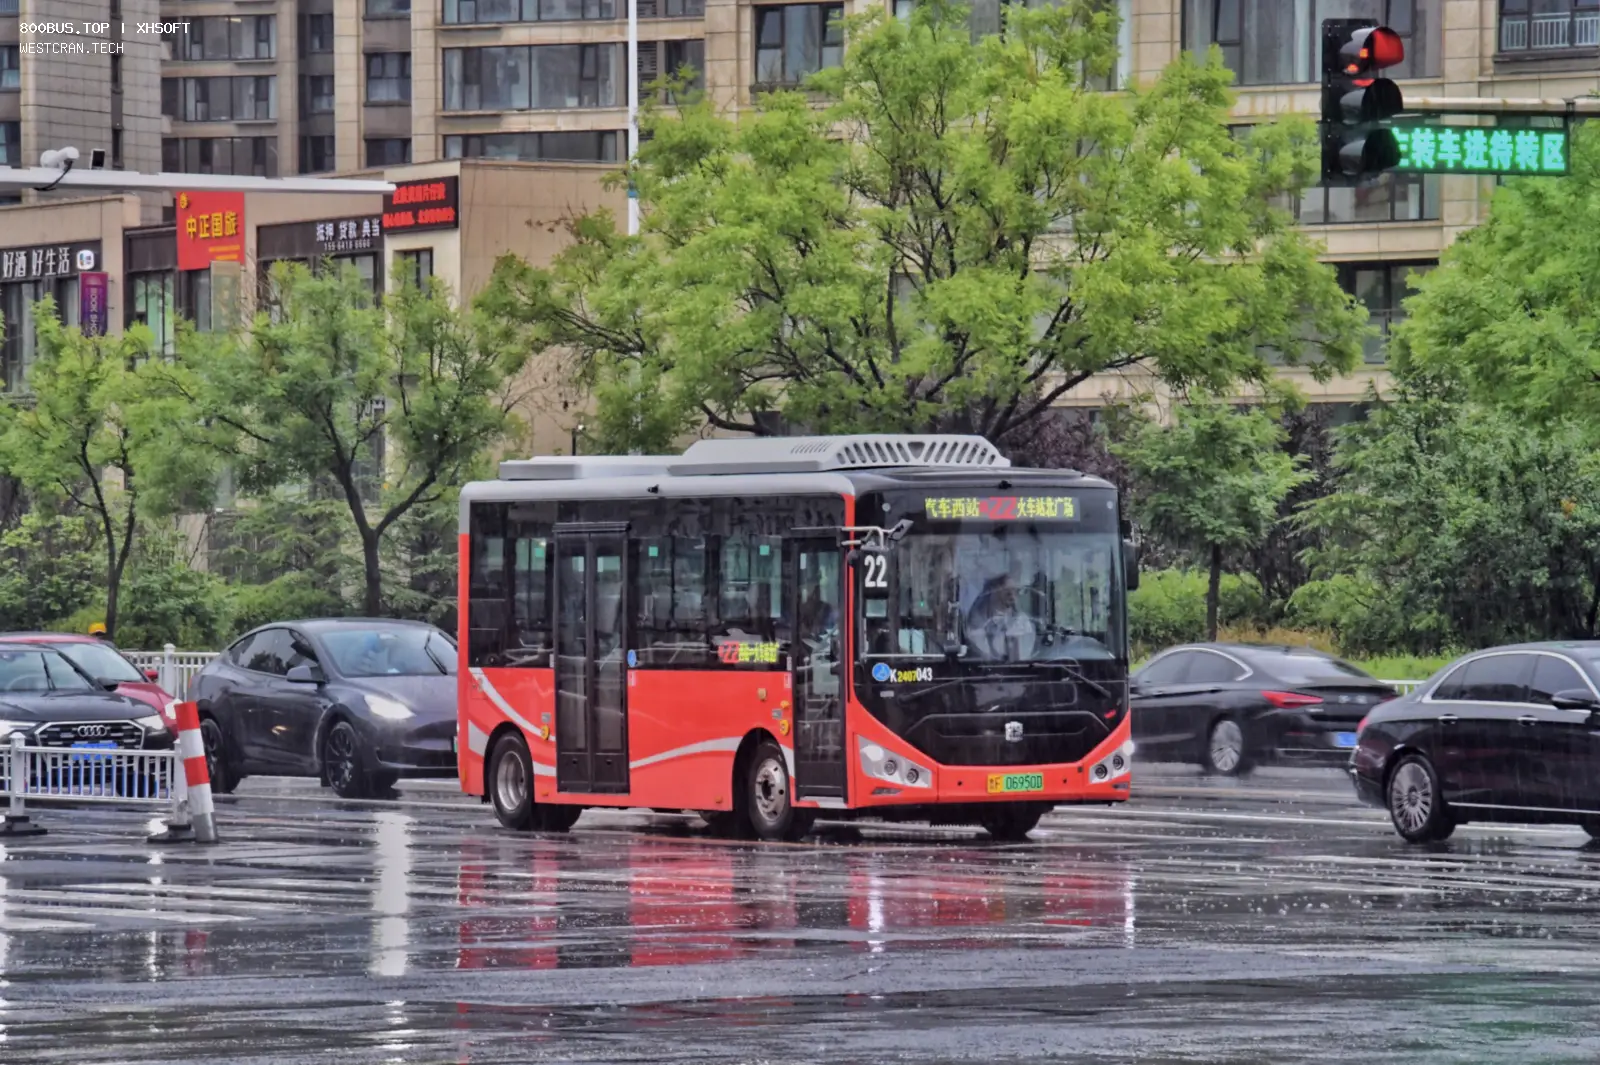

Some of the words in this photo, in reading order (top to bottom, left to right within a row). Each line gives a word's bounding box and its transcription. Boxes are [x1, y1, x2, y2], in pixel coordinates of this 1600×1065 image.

[3, 251, 27, 278] 好酒
[32, 247, 70, 276] 好生活
[925, 497, 980, 518] 汽车西站
[864, 554, 888, 588] 22
[889, 667, 933, 683] K2407043
